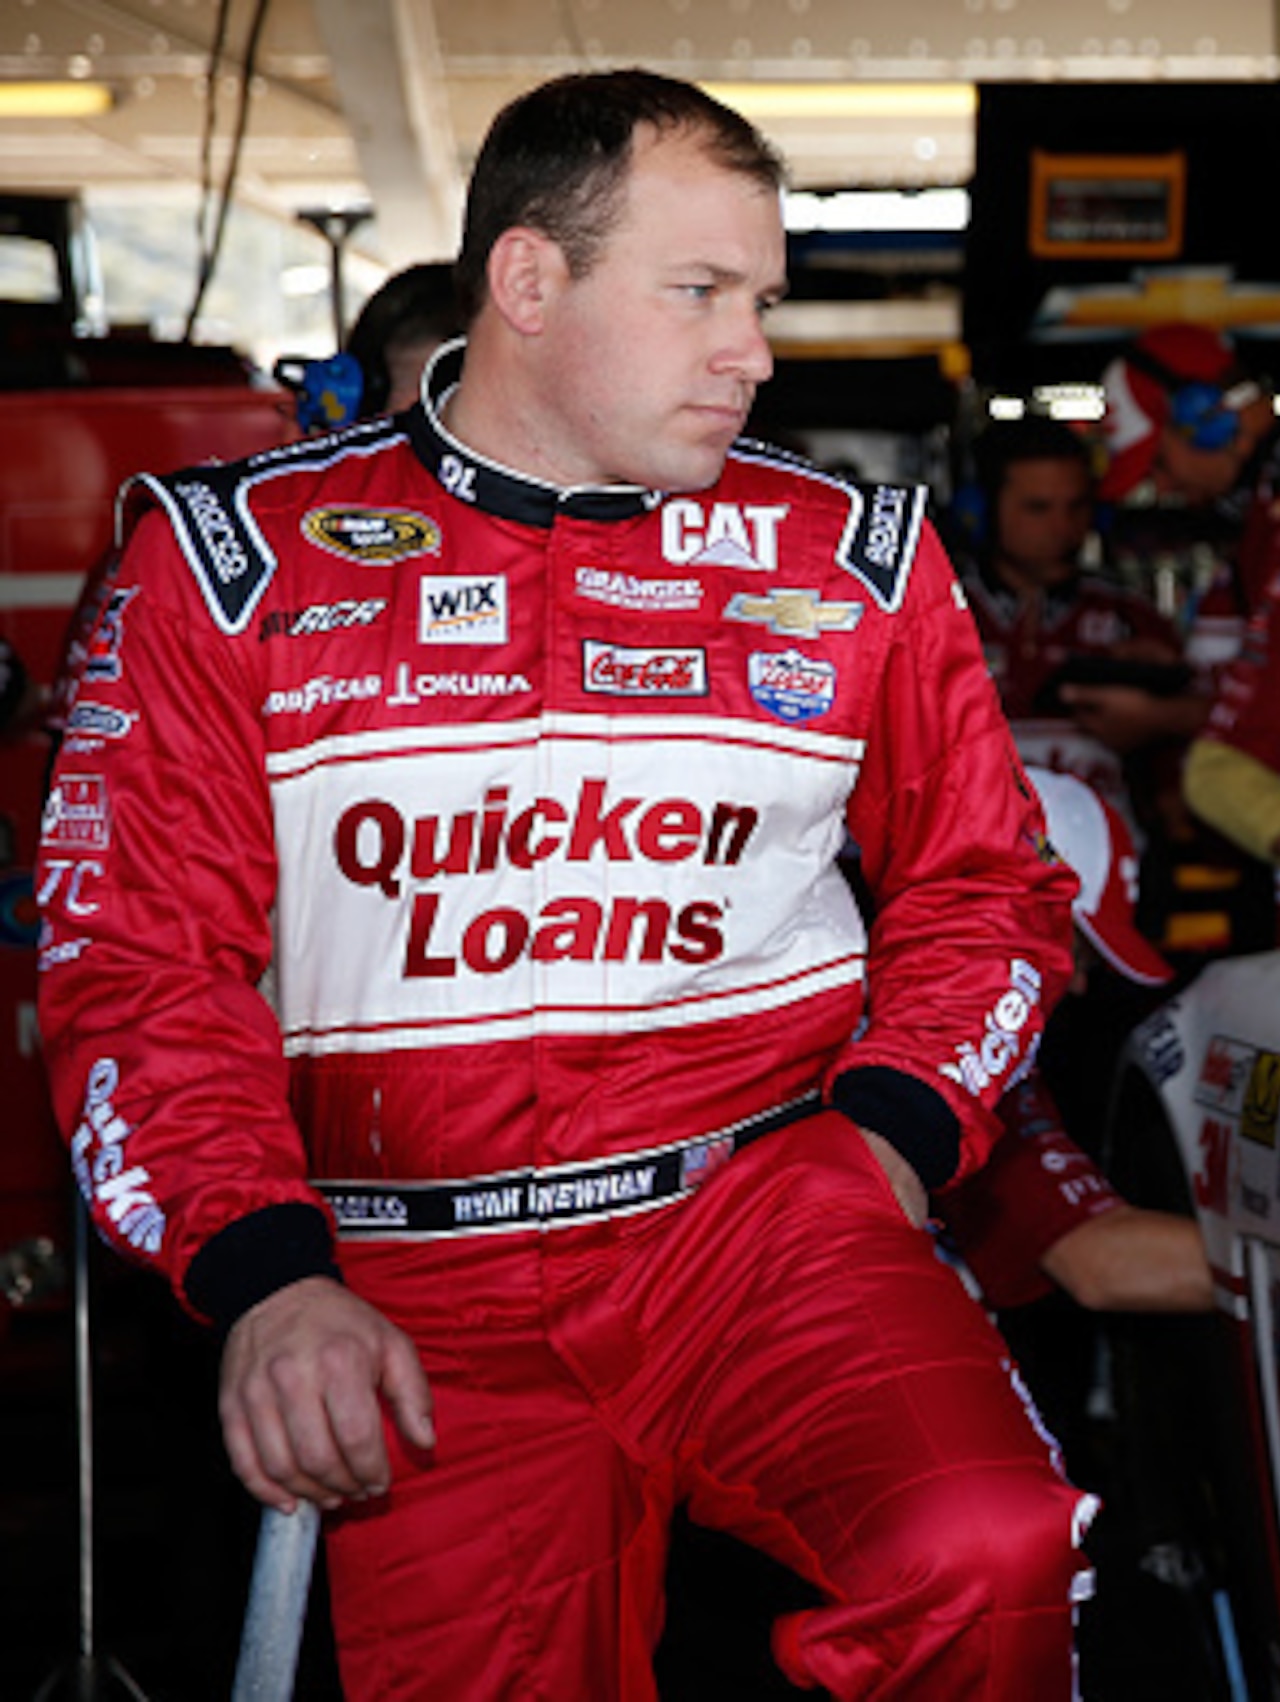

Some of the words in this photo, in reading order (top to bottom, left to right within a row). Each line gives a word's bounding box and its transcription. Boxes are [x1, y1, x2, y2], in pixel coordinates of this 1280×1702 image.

[661, 499, 790, 571] CAT
[428, 582, 497, 616] WIX
[333, 776, 759, 899] Quicken
[403, 892, 725, 980] Loans
